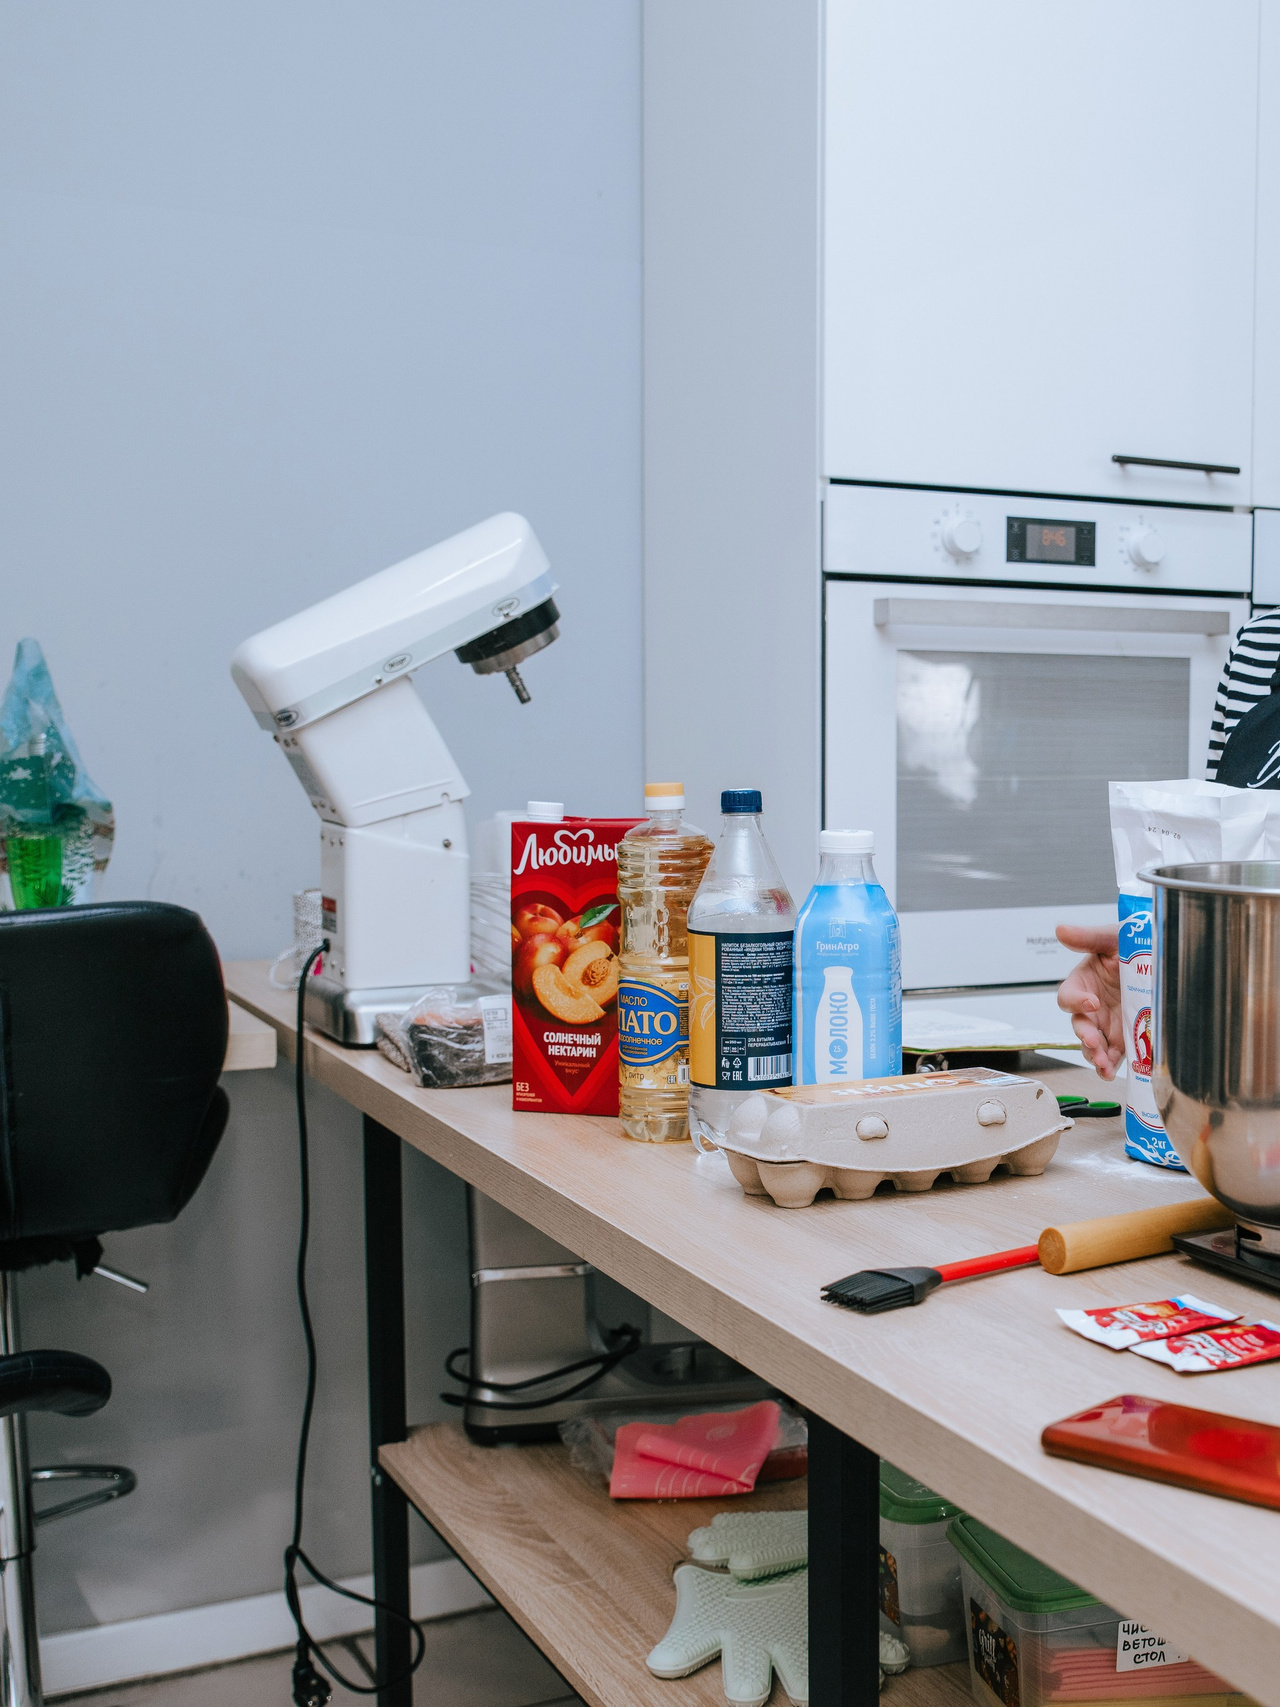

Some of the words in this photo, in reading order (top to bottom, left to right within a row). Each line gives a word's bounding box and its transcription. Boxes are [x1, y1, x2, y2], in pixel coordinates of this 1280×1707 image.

[513, 828, 618, 875] Любимы
[816, 941, 859, 952] ГринАгро
[620, 994, 648, 1007] МАСЛО
[543, 1032, 601, 1046] СОЛНЕЧНЫЙ
[548, 1045, 597, 1058] НЕКТАРИН
[554, 1060, 591, 1068] Уникальный
[516, 1082, 530, 1092] БЕЗ
[1152, 1137, 1167, 1150] 2кг
[1122, 1623, 1149, 1635] ЧИС
[1122, 1637, 1167, 1652] ВЕТОШ
[1133, 1651, 1166, 1665] СТОЛ
